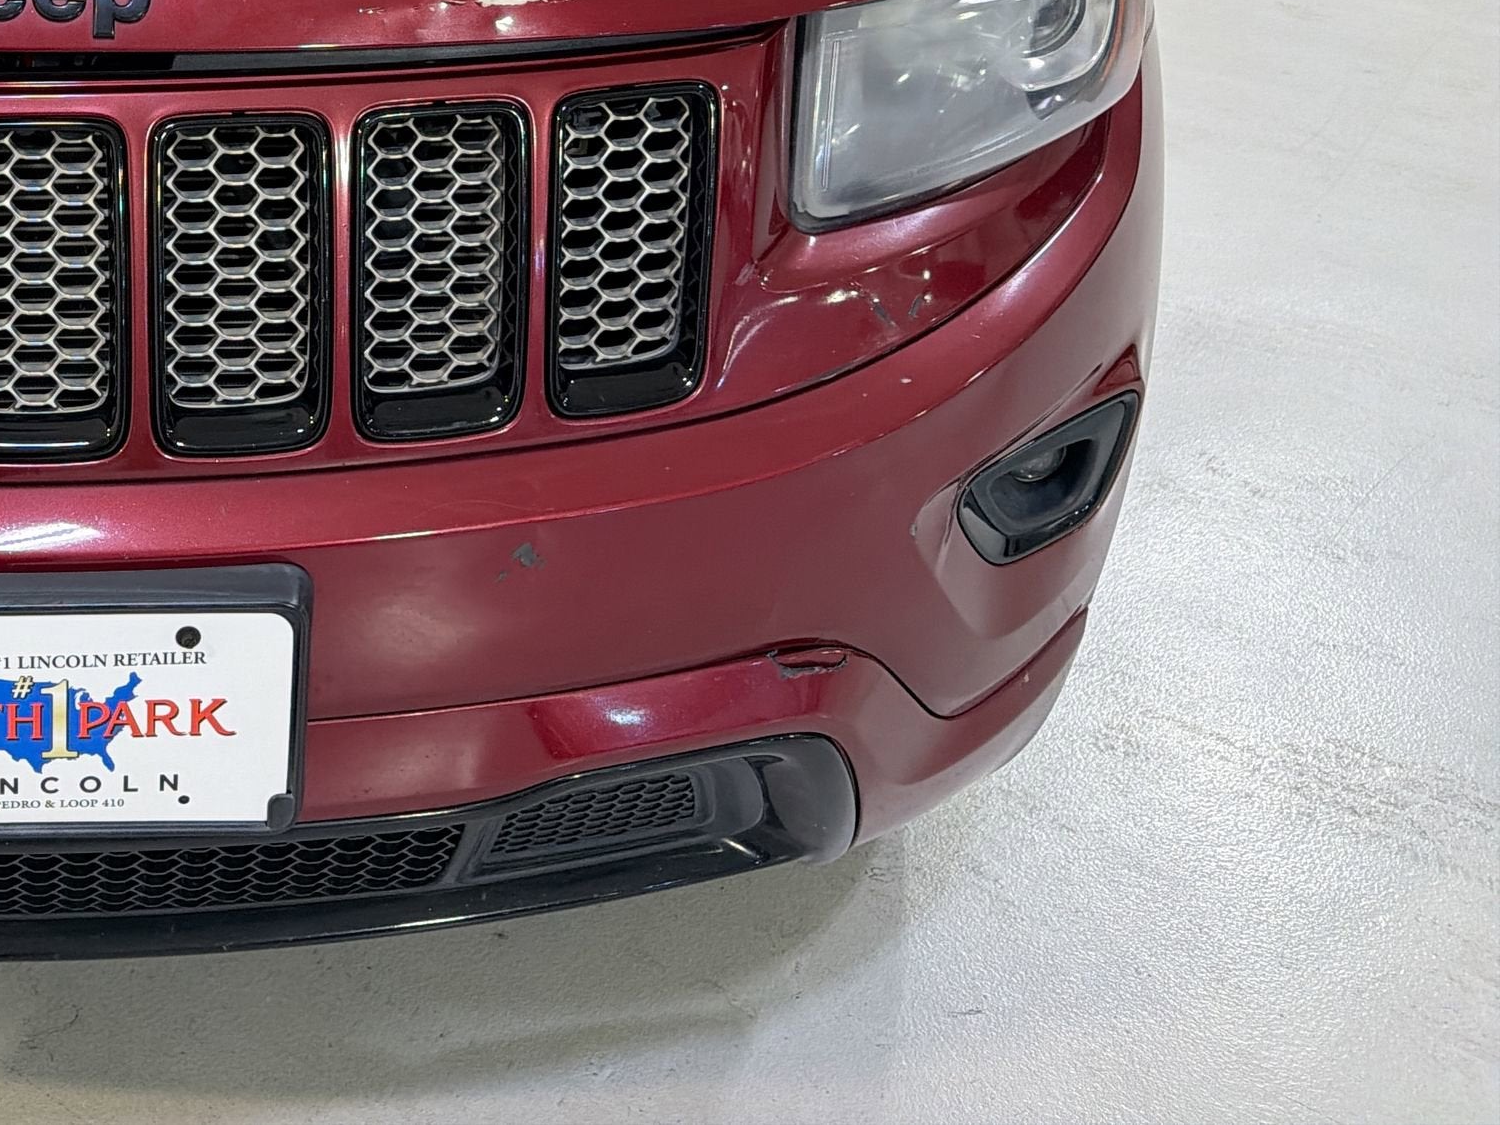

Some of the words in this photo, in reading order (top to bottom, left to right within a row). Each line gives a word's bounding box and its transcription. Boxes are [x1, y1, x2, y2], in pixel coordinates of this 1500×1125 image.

[18, 654, 107, 669] LINCOLN
[113, 651, 207, 667] RETAILER
[77, 698, 237, 740] PARK
[44, 799, 56, 809] &
[59, 798, 99, 809] LOOP
[101, 798, 125, 808] 410
